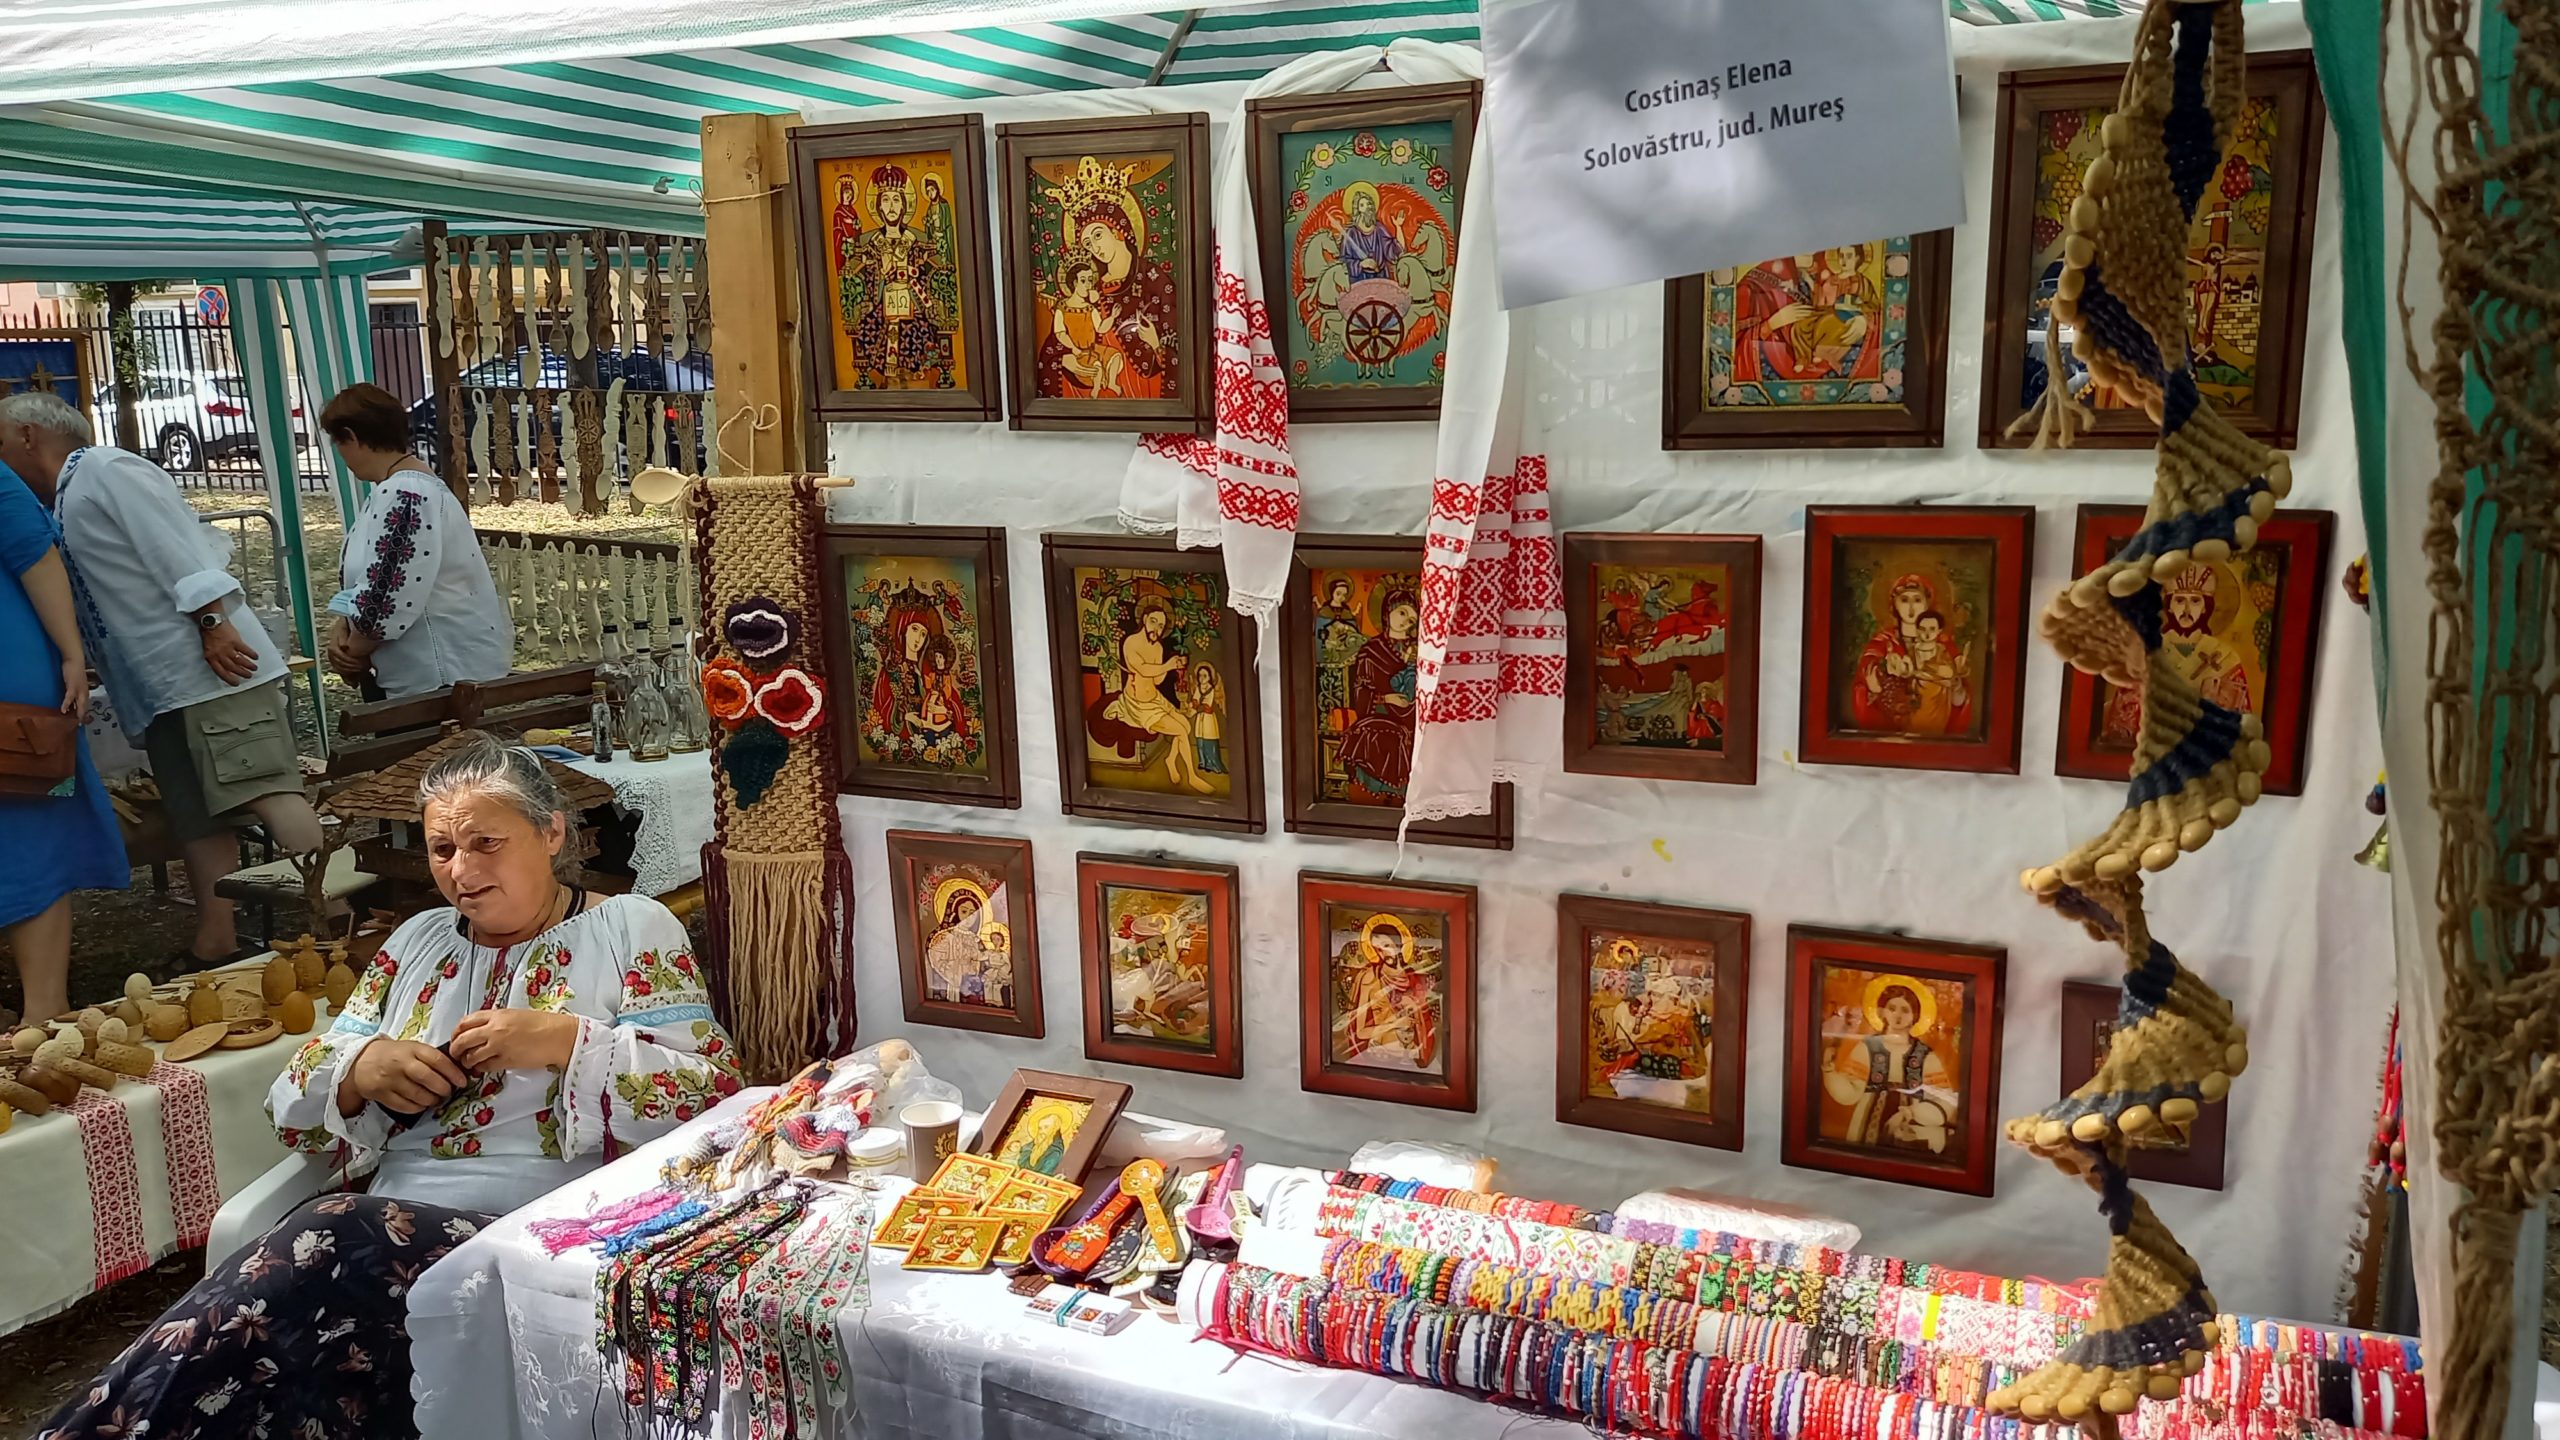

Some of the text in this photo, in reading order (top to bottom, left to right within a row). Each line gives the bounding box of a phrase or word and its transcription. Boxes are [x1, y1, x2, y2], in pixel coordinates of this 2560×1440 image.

[1727, 58, 1793, 90] Elena
[1584, 129, 1712, 171] Solovăstru,
[1716, 111, 1764, 148] jud.
